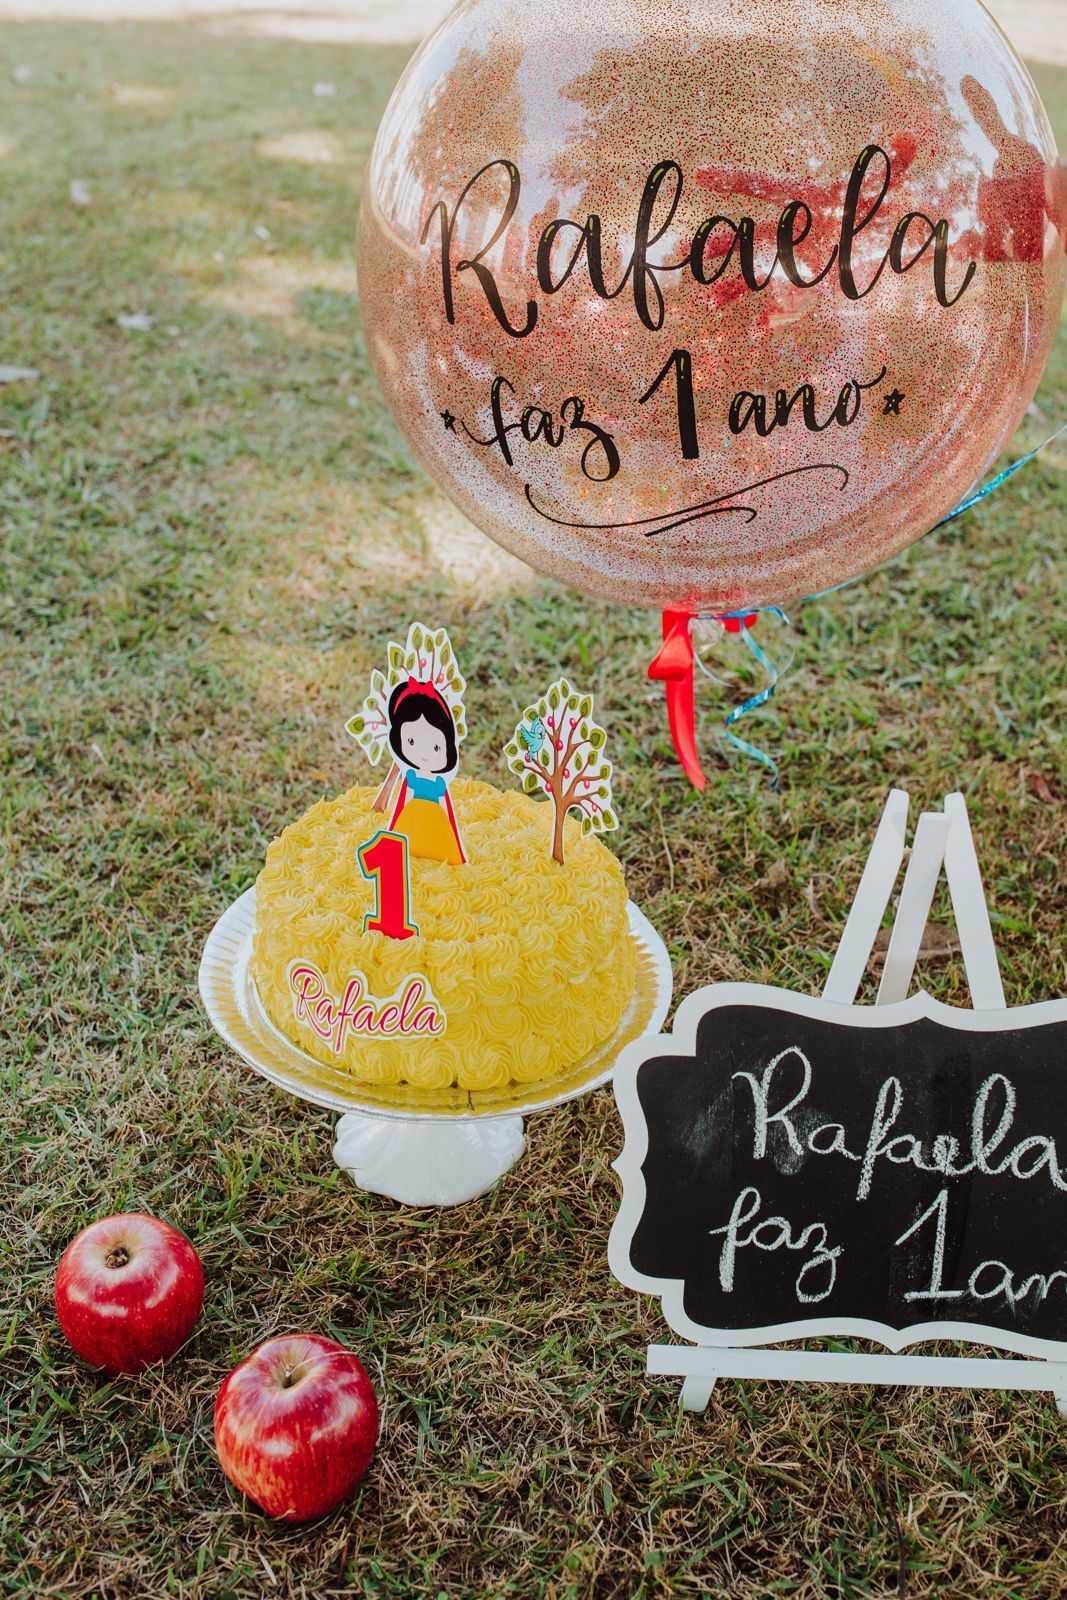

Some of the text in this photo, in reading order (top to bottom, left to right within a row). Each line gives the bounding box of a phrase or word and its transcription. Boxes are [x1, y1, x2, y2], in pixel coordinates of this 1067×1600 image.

[420, 145, 976, 338] Rafaela
[461, 349, 888, 482] faz 1 ano
[359, 831, 420, 940] 1
[291, 967, 443, 1053] Rafaela
[731, 1045, 1067, 1202] Rafaela
[709, 1186, 844, 1304] faz
